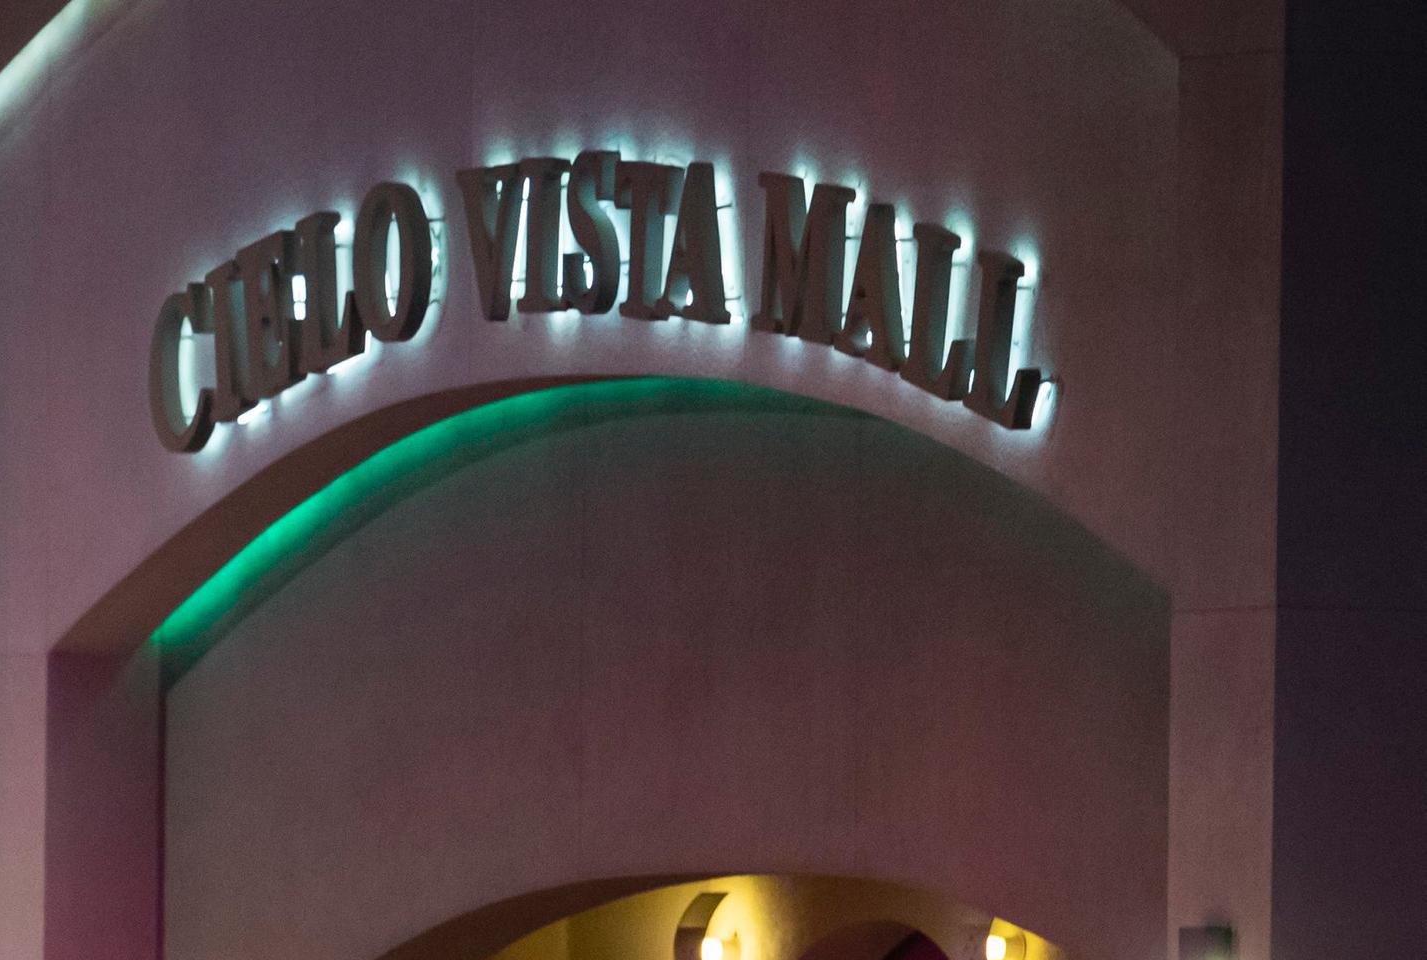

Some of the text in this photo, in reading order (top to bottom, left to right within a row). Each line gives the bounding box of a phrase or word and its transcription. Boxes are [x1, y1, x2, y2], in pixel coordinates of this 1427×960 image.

[148, 150, 1044, 453] CIELO VISTA MALL
